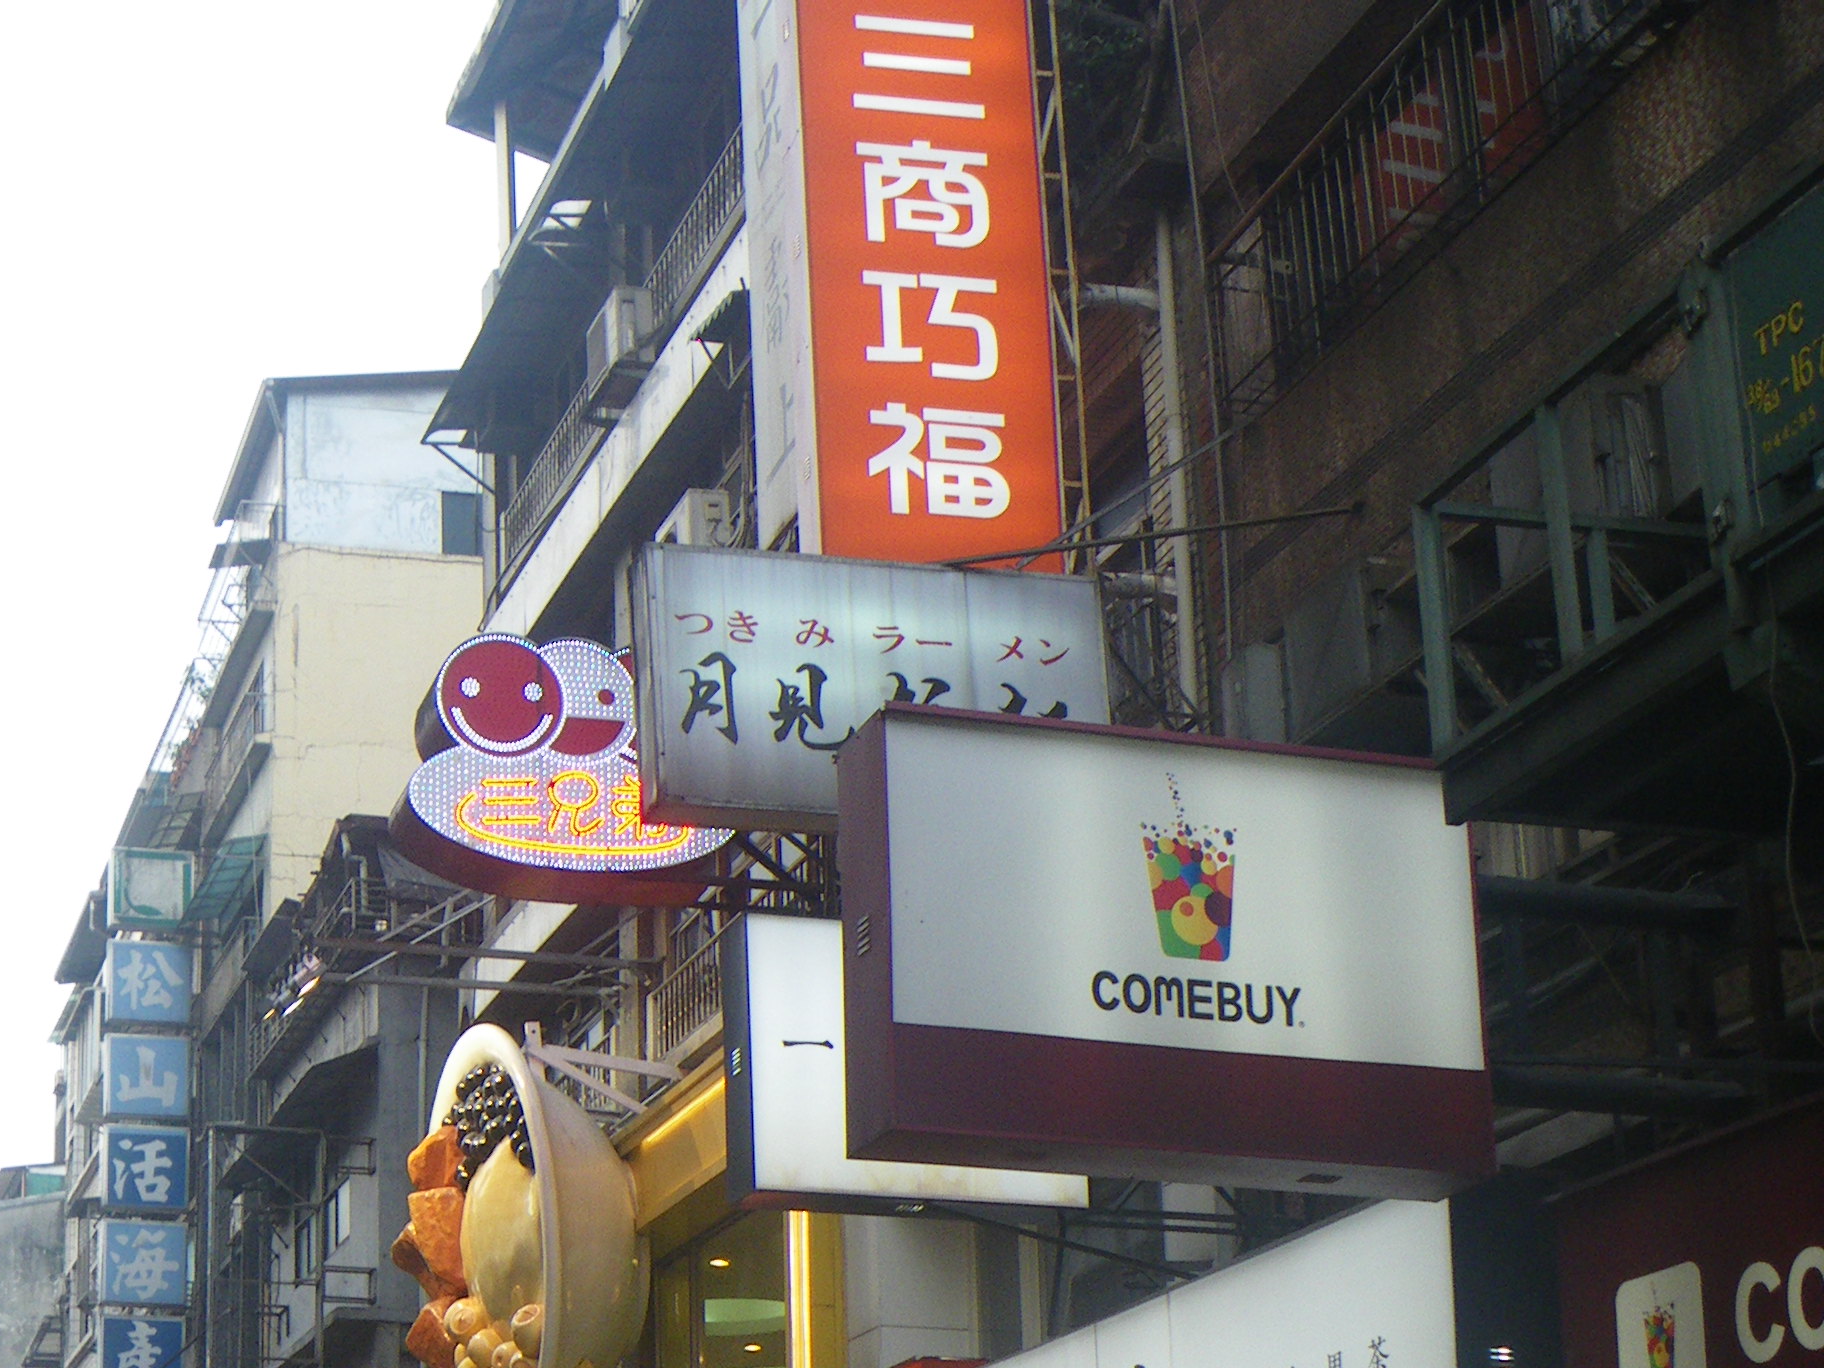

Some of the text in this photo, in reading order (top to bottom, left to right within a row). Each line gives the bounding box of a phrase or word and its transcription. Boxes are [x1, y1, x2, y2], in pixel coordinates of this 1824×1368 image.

[853, 14, 1011, 519] 三商巧福
[1754, 300, 1805, 356] TPC
[1092, 970, 1302, 1028] COMEBUY
